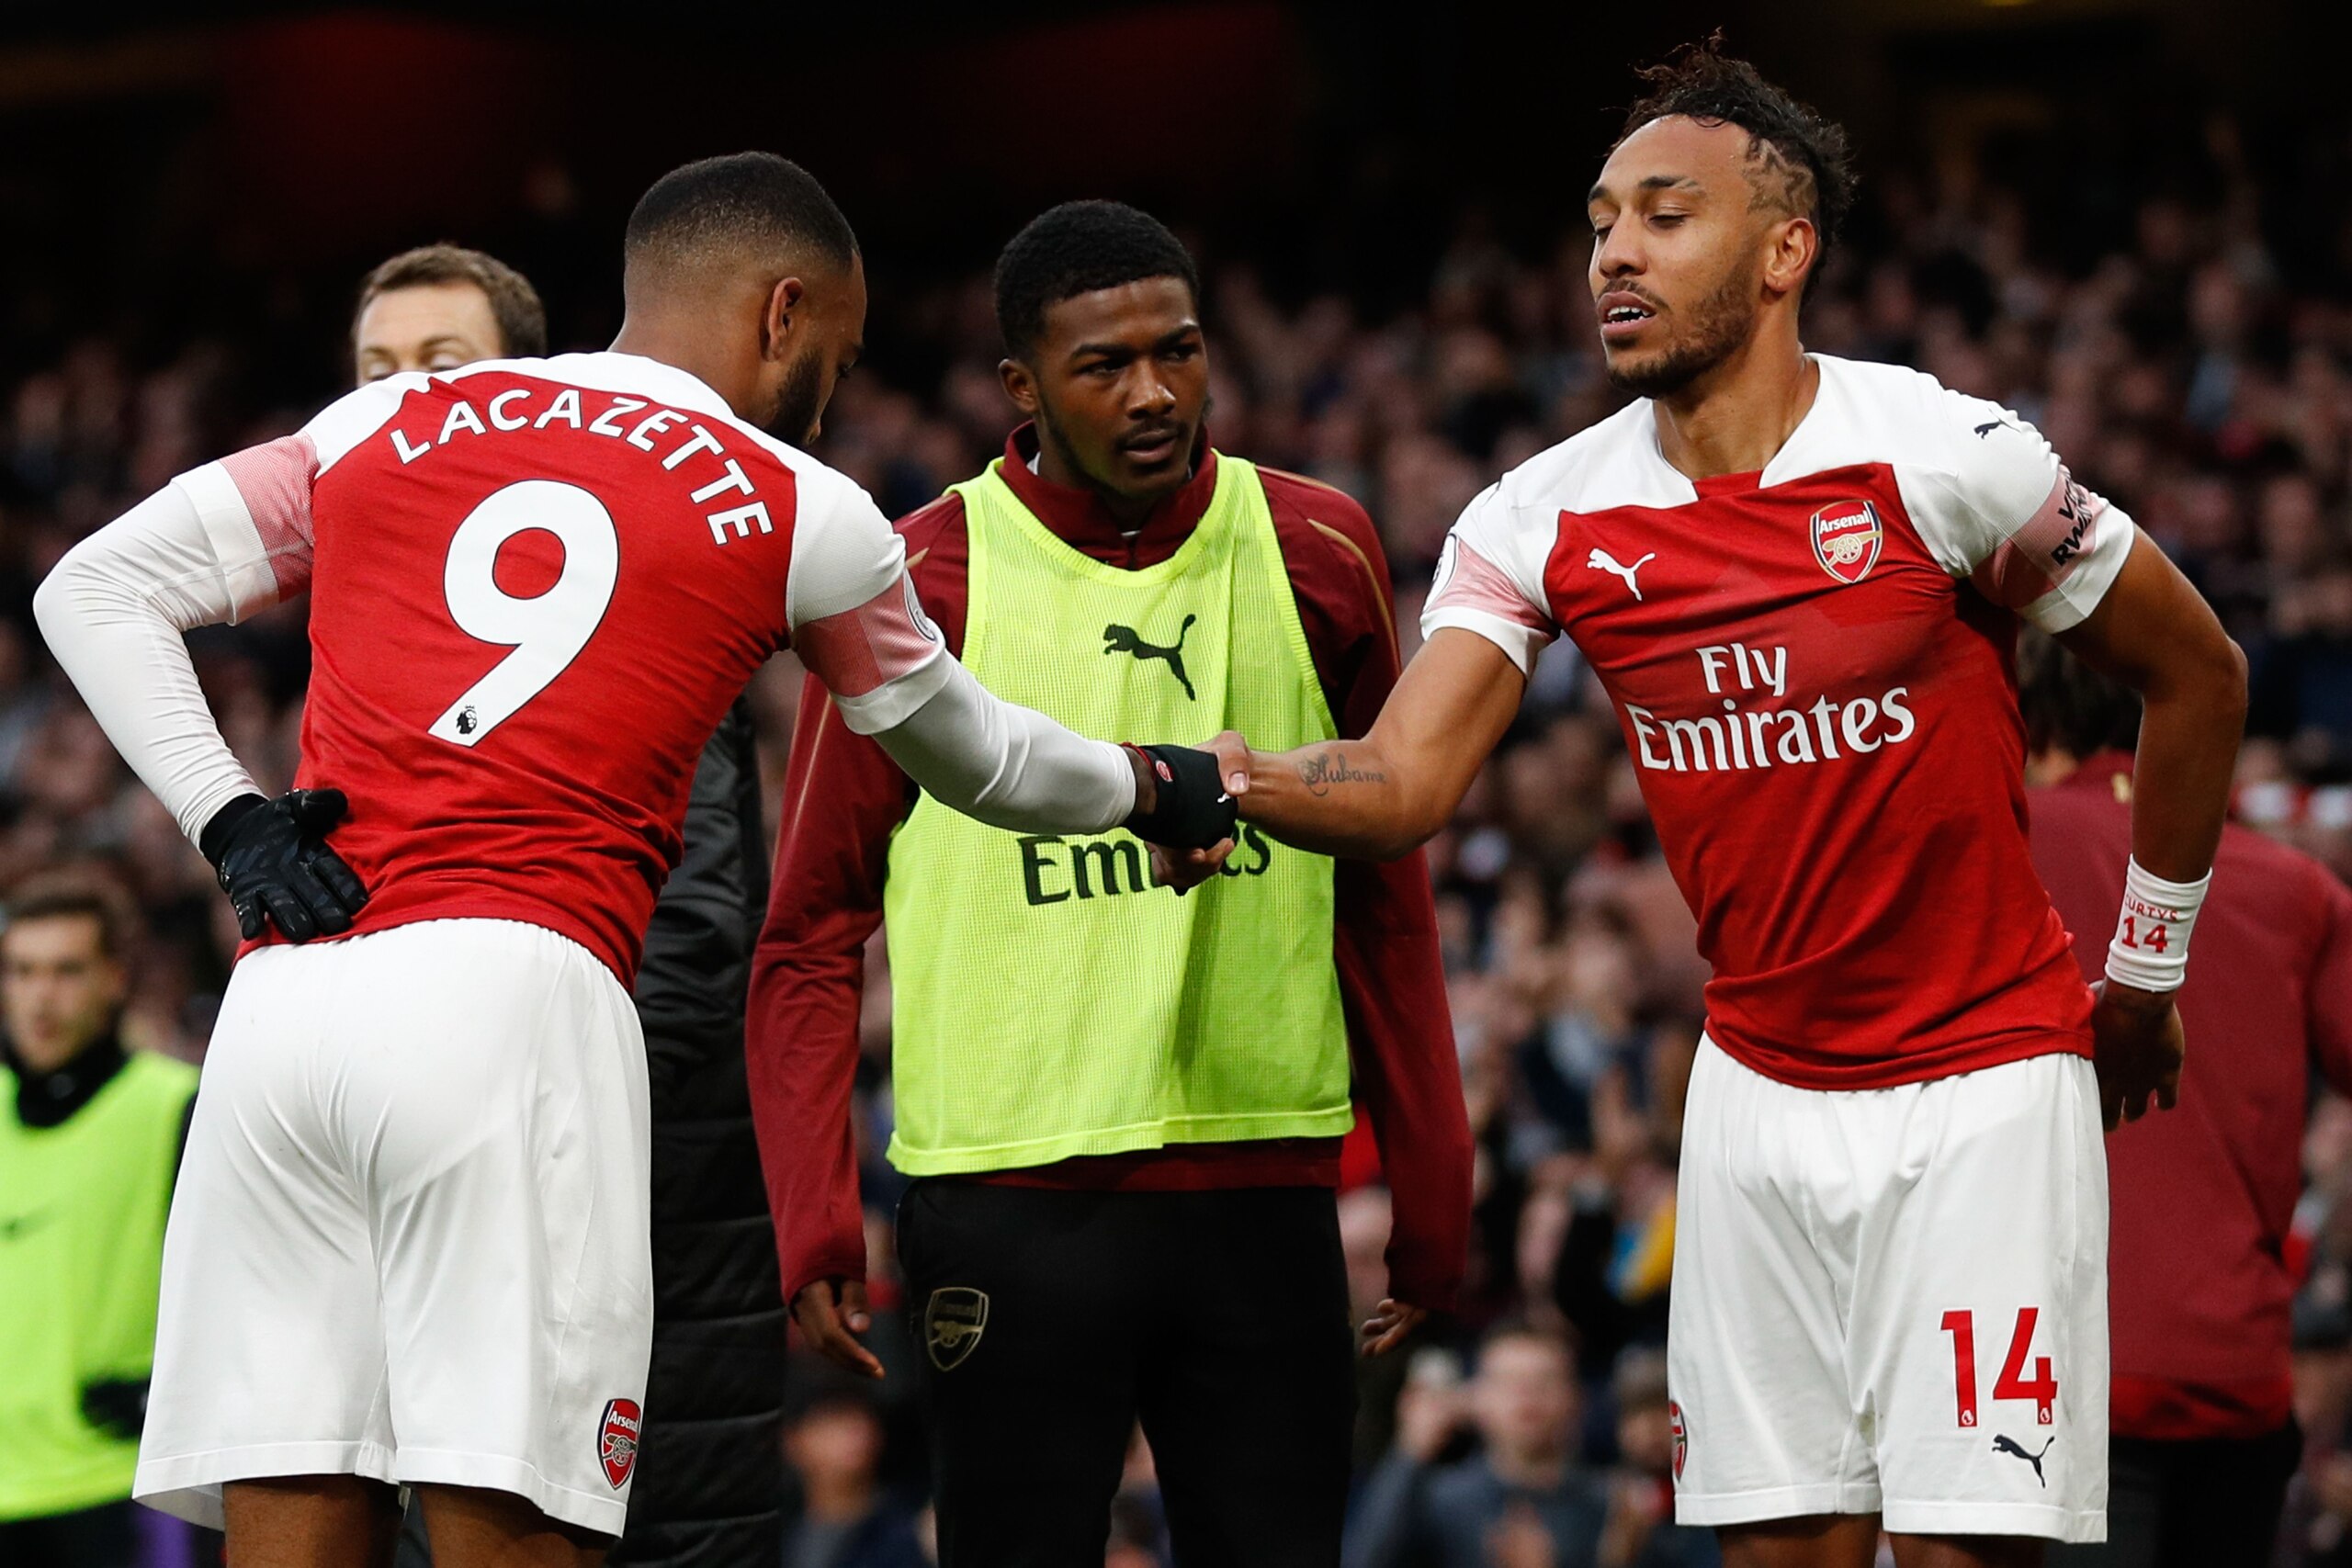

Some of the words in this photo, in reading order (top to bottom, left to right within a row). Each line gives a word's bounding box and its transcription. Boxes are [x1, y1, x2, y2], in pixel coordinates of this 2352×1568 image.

[390, 389, 774, 546] LACAZETTE
[1819, 510, 1871, 535] Arsenal
[427, 479, 620, 748] 9
[1696, 642, 1787, 696] Fly
[1624, 687, 1915, 772] Emirates
[2121, 915, 2168, 953] 14
[1940, 1306, 2058, 1427] 14
